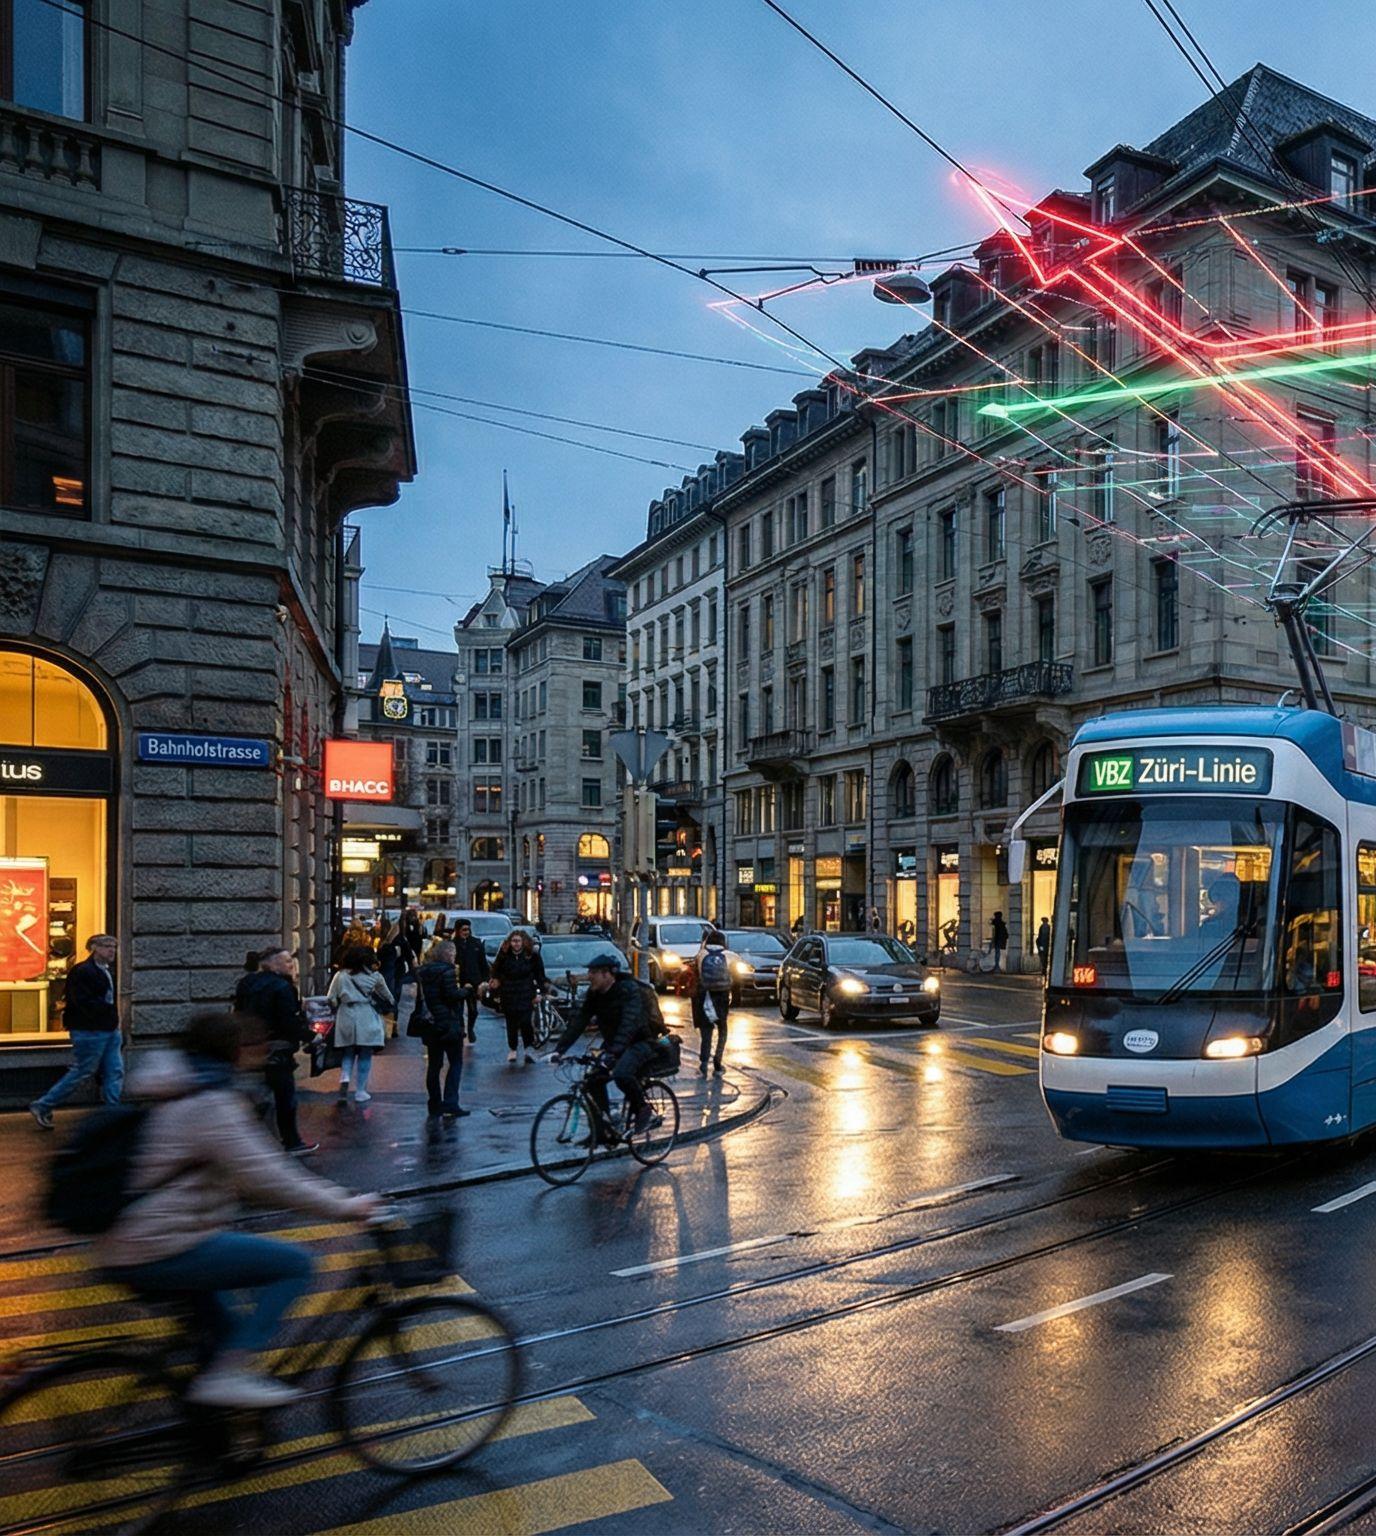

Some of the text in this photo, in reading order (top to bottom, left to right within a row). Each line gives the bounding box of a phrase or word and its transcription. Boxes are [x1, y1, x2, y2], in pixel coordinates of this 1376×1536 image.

[148, 738, 262, 760] Bahnhofstrasse
[1093, 756, 1257, 786] VBZ Züri-Linie
